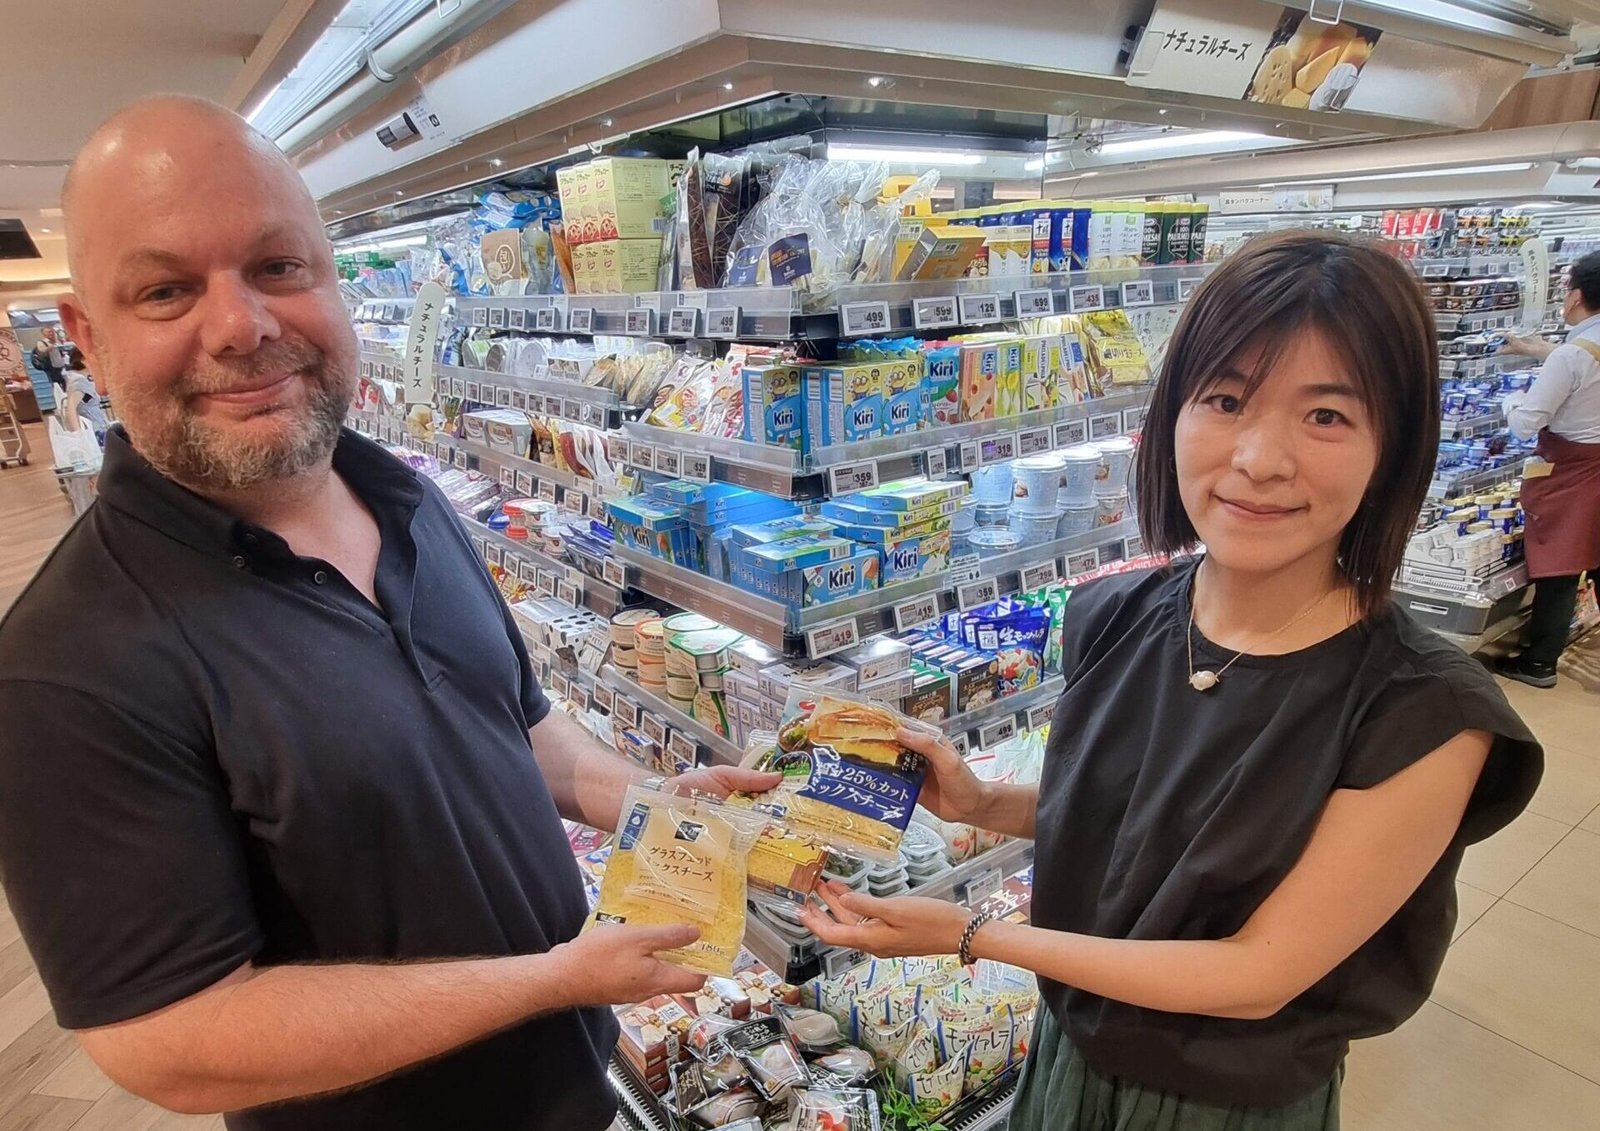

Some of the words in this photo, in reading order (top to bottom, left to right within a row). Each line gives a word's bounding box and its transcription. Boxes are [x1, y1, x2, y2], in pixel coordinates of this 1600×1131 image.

[1163, 28, 1252, 61] ナチュラルチーズ
[866, 311, 884, 322] 499
[413, 302, 435, 388] ナチュラルチーズ
[985, 353, 994, 372] Kiri
[1010, 348, 1018, 367] Kiri
[930, 360, 954, 377] Kiri
[773, 408, 793, 426] Kiri
[854, 408, 873, 426] Kiri
[892, 402, 910, 420] Kiri
[854, 471, 872, 483] 359
[631, 525, 651, 548] Kiri
[894, 547, 918, 571] Kiri
[828, 563, 855, 590] Kiri
[917, 605, 933, 616] 419
[834, 629, 852, 642] 419
